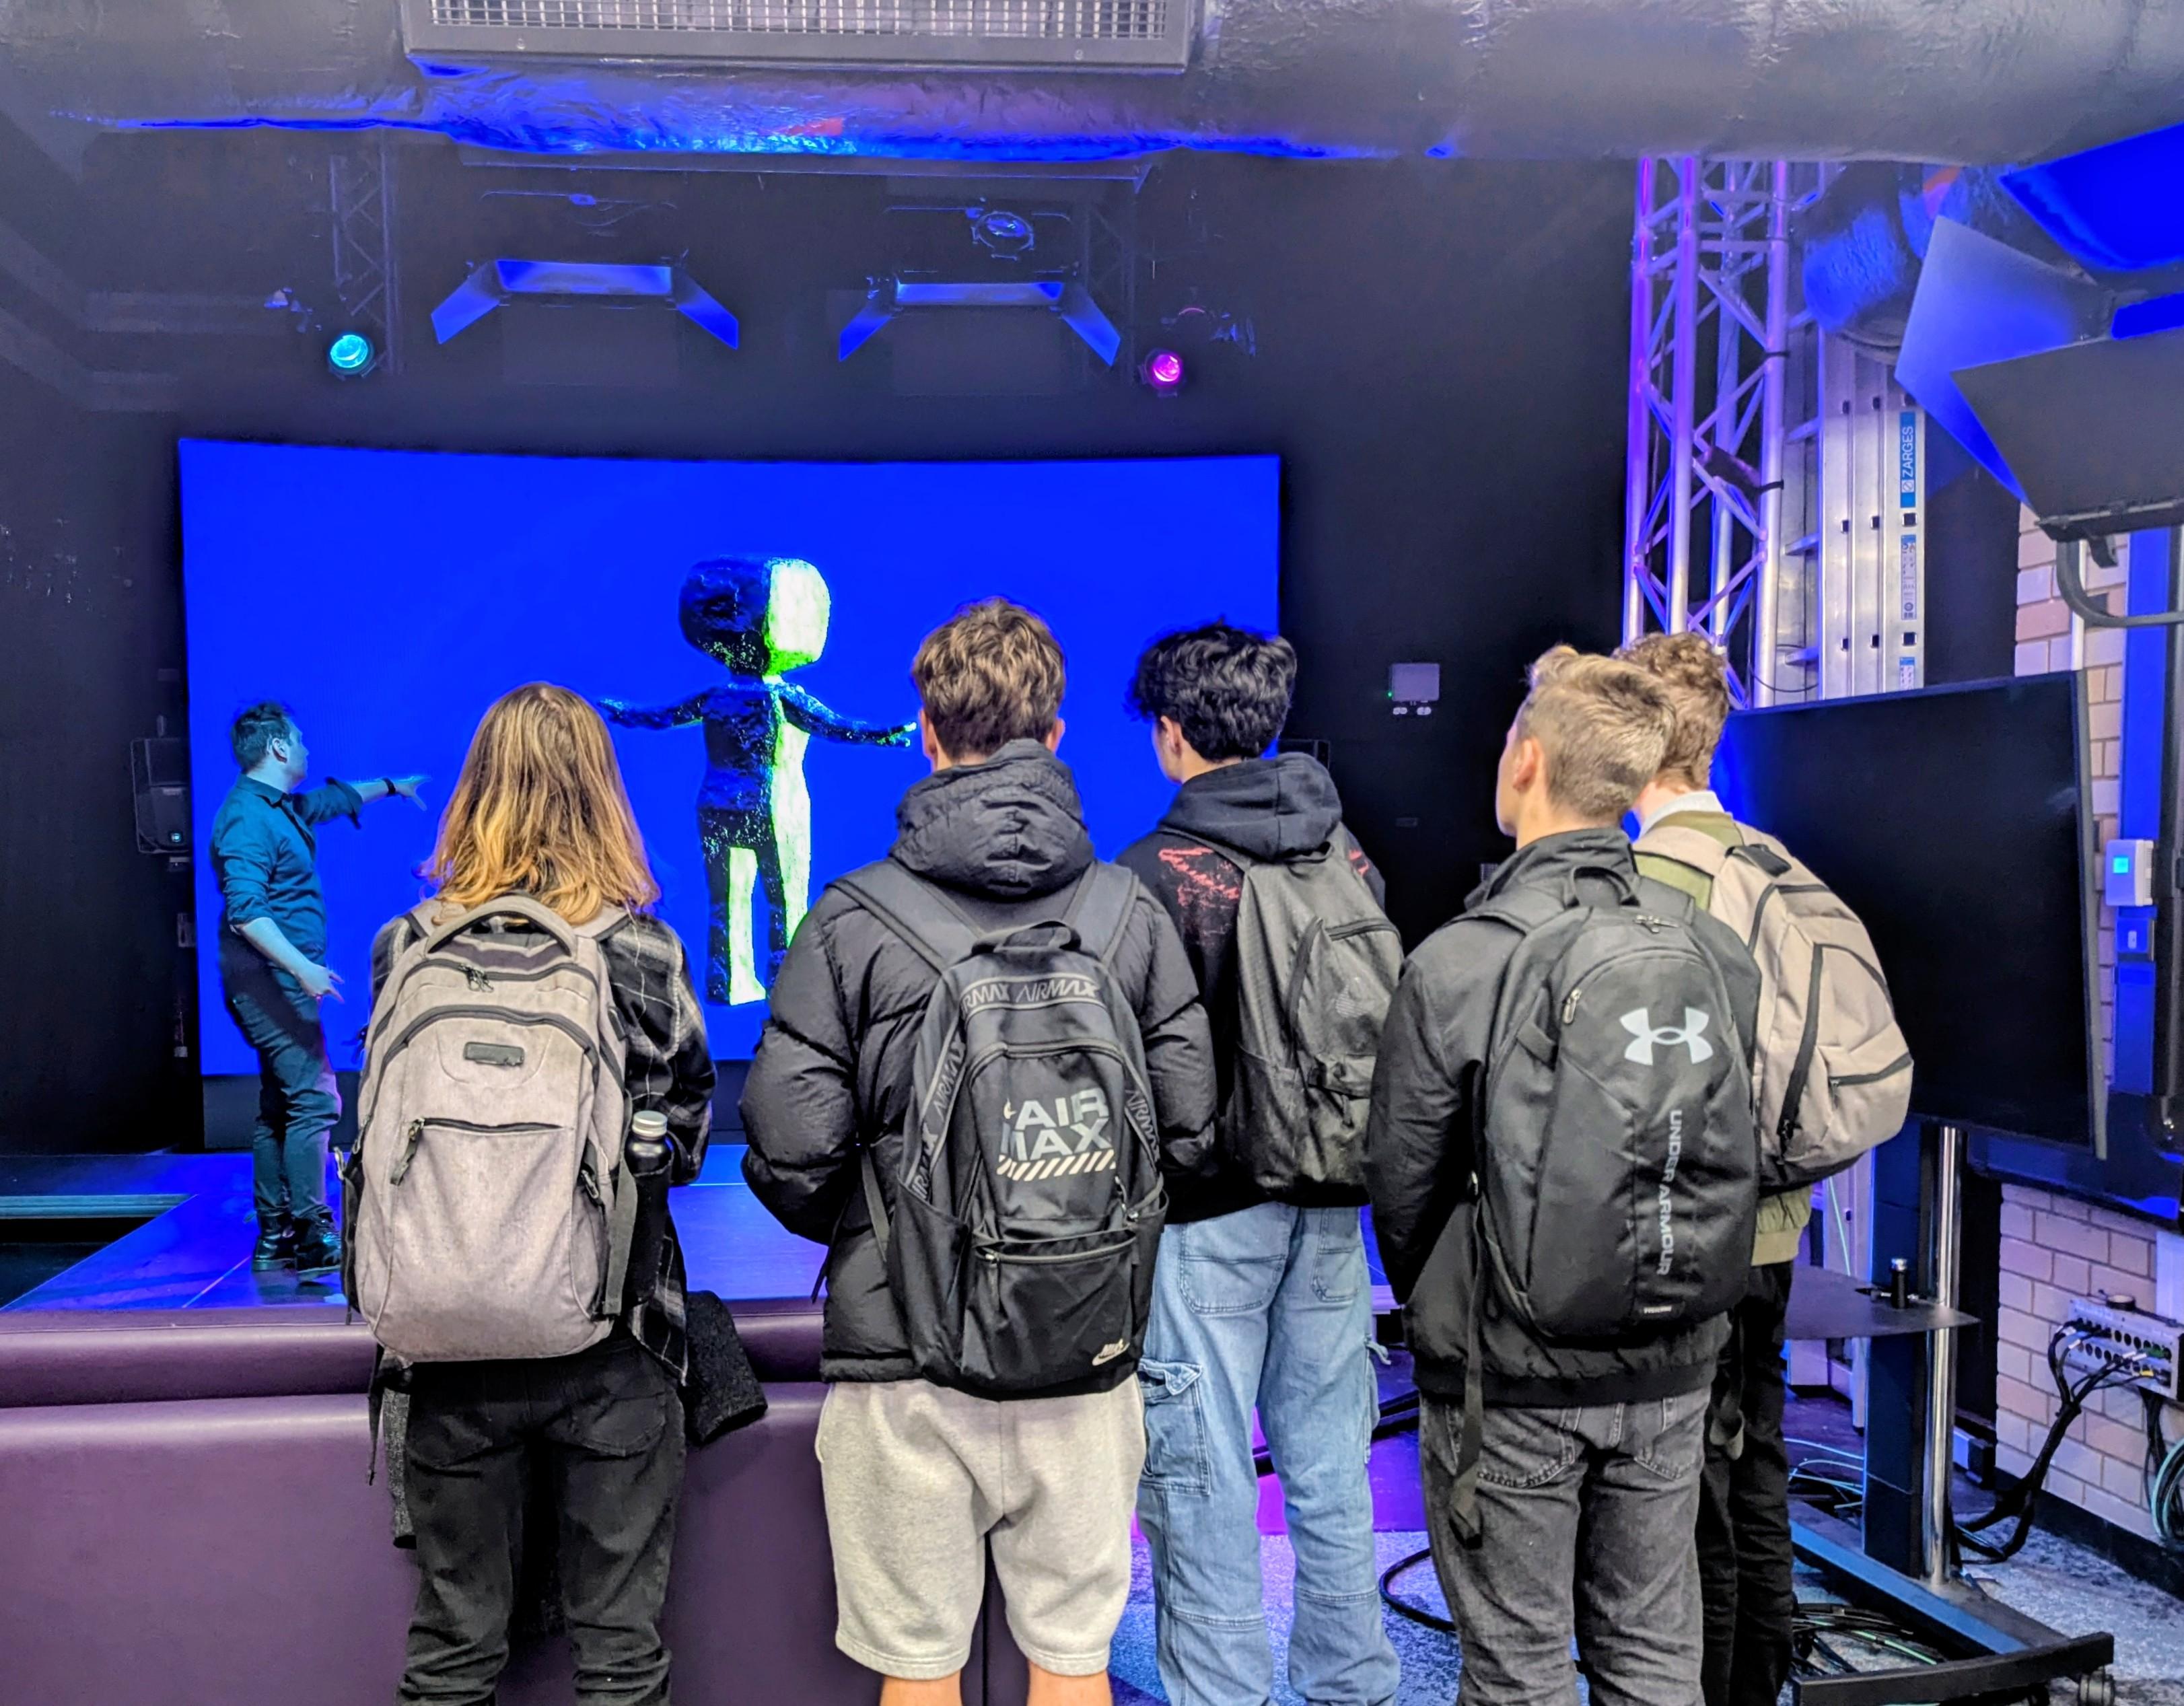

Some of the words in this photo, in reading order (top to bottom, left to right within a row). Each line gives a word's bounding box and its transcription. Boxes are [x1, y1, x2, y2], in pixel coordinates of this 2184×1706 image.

[1902, 426, 1913, 477] ZARGES
[1016, 979, 1099, 1003] AIRMAX
[1015, 1088, 1109, 1131] AIR
[1662, 1110, 1682, 1182] UNDER
[1656, 1184, 1674, 1275] ARMOUR
